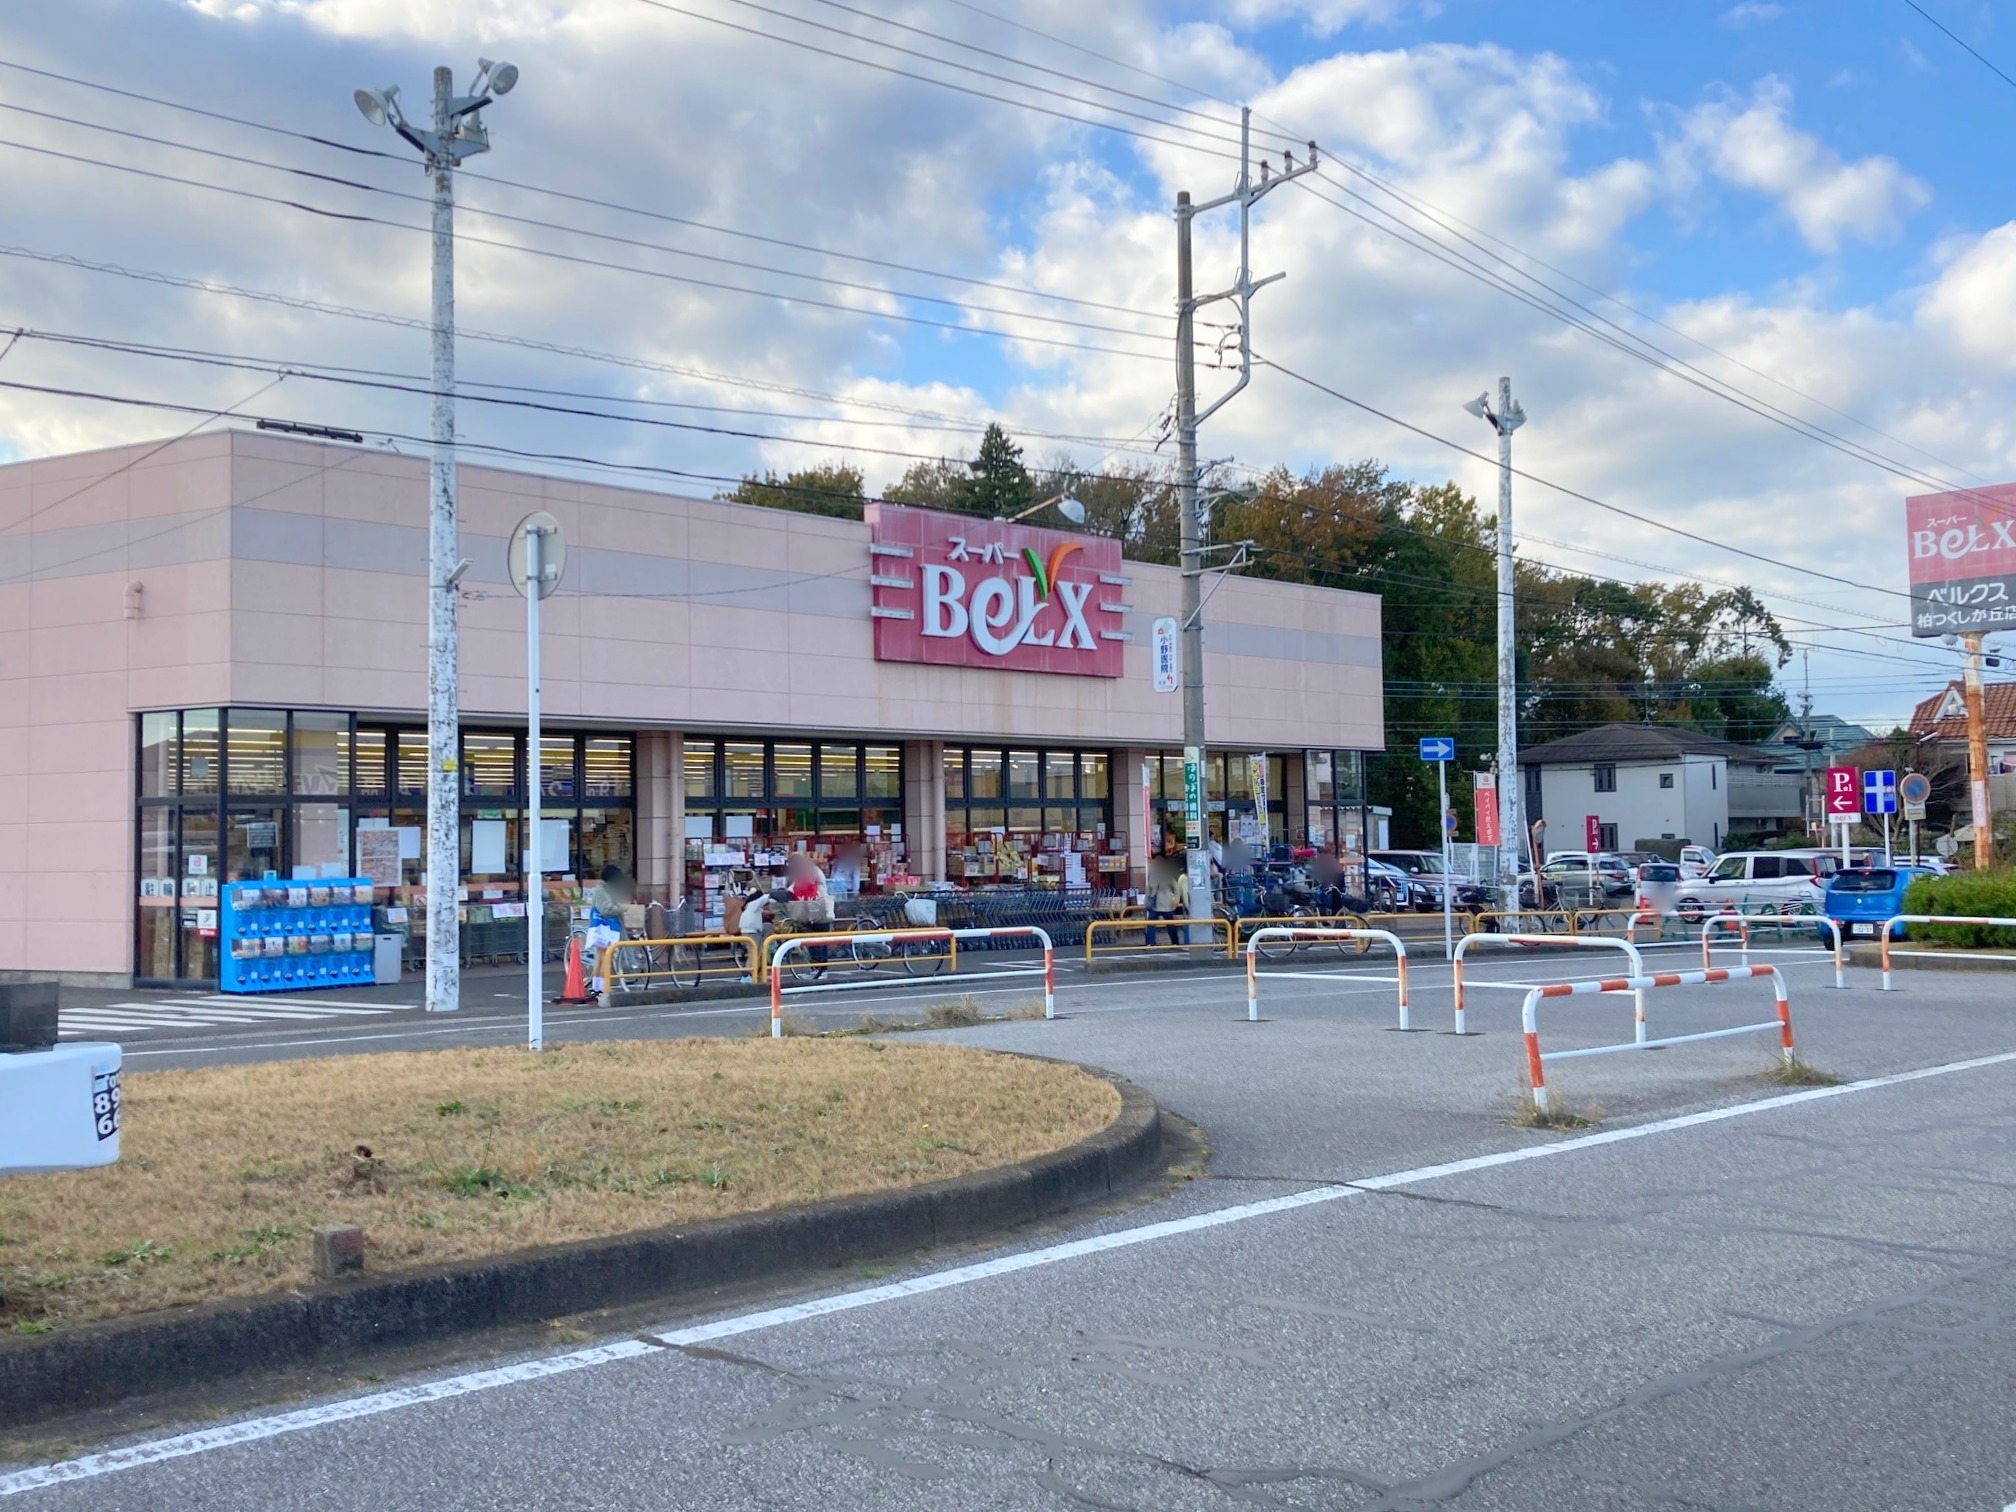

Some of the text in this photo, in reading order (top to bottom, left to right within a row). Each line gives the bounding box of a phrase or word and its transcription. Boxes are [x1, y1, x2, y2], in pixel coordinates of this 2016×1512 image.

[1927, 515, 1968, 529] スーパー
[947, 536, 1021, 565] スーパー
[1926, 582, 2009, 606] ベルクス
[1917, 605, 2016, 629] 柏つくしが丘店
